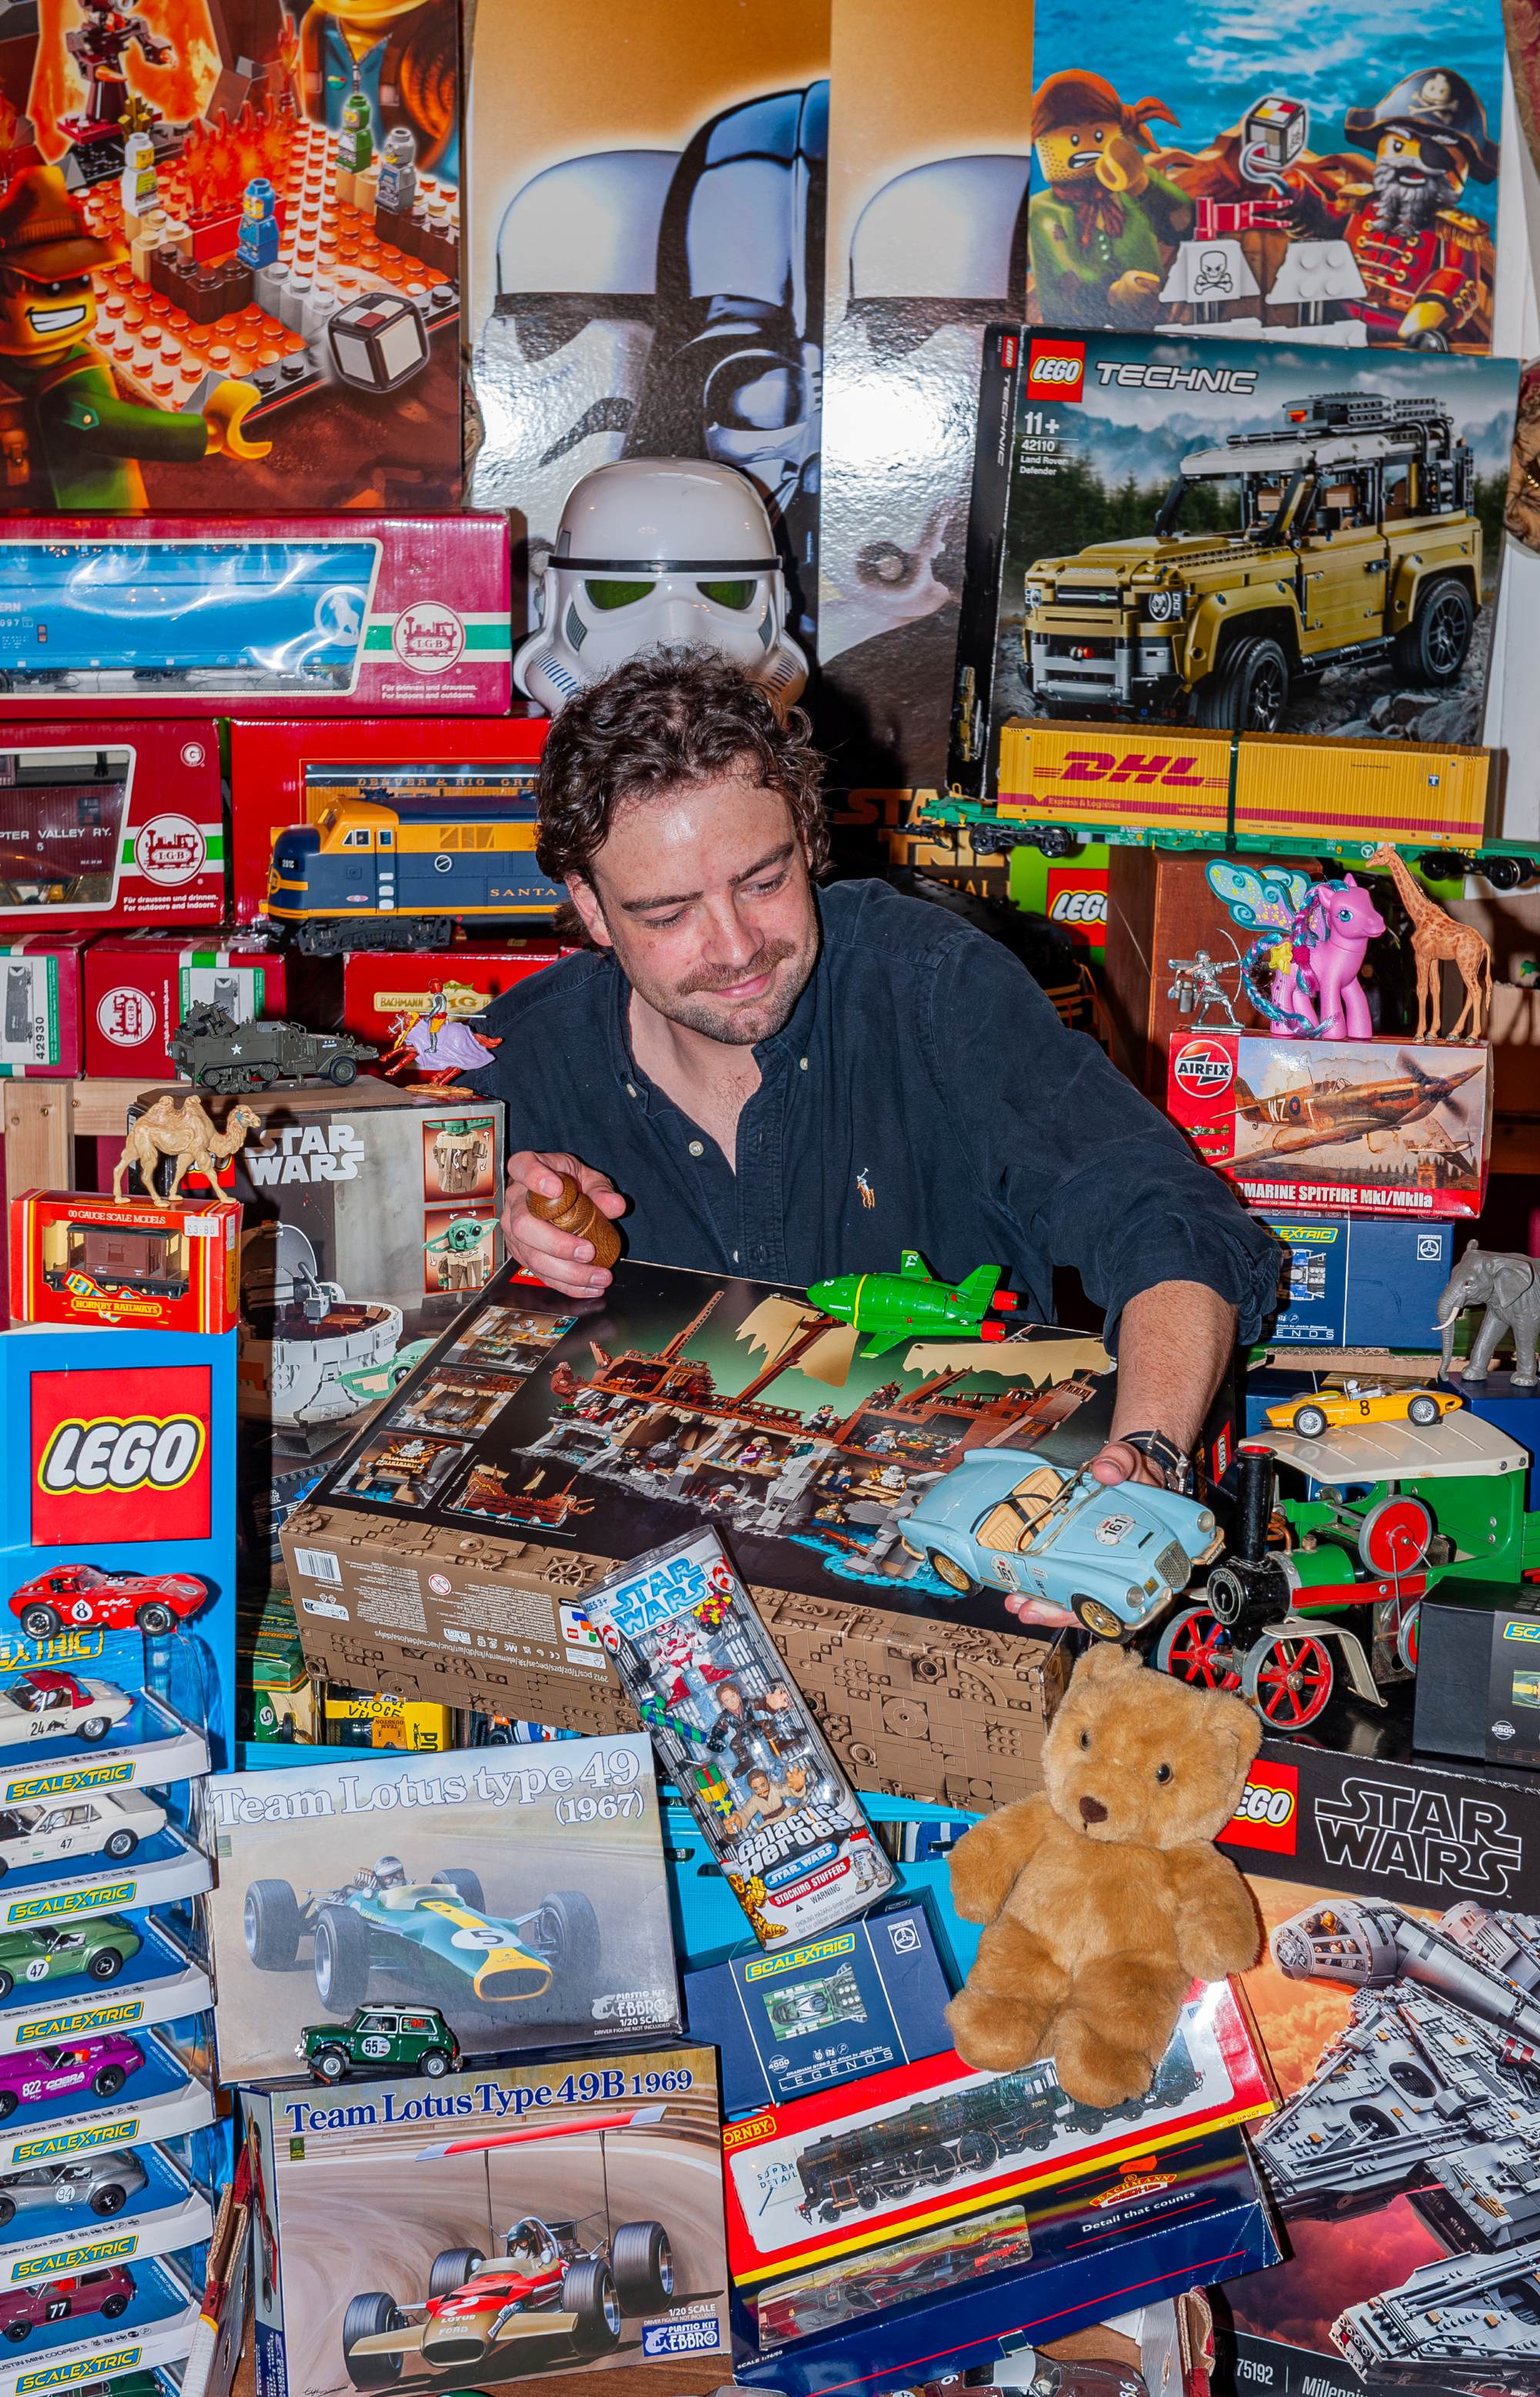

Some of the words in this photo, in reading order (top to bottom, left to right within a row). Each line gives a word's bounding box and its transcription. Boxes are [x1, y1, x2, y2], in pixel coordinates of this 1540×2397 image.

[1006, 339, 1014, 364] LEGO
[1031, 357, 1081, 384] LEGO
[1095, 361, 1258, 395] TECHNIC
[997, 374, 1011, 467] TECHNIC
[1024, 411, 1060, 435] 11+
[1021, 439, 1056, 452] 42110
[1020, 455, 1041, 464] Land
[1043, 457, 1068, 465] Rover
[1019, 465, 1057, 475] Defender
[1060, 751, 1205, 787] DHL
[357, 777, 427, 787] DENVER
[455, 777, 485, 786] RIO
[1048, 797, 1078, 807] Express
[1086, 800, 1121, 810] Logistics
[38, 828, 85, 839] VALLEY
[92, 827, 112, 837] RY.
[123, 896, 136, 904] Für
[489, 888, 557, 897] SANTA
[123, 904, 136, 913] For
[136, 903, 170, 912] outdoors
[1052, 891, 1107, 924] LEG
[380, 997, 424, 1007] BACHMANN
[35, 1016, 45, 1060] 42930
[1177, 1061, 1230, 1078] AIRFIX
[1267, 1098, 1290, 1124] WZ
[245, 1124, 364, 1155] STAR
[246, 1152, 365, 1186] WARS
[1298, 1185, 1358, 1204] SPITFIRE
[78, 1210, 105, 1221] GAUGE
[106, 1212, 132, 1222] SCALE
[133, 1214, 166, 1225] MODELS
[75, 1299, 112, 1311] HORNBY
[113, 1301, 159, 1314] RAILWAYS
[1358, 1400, 1371, 1416] 8
[41, 1416, 203, 1493] LEGO
[1104, 1517, 1128, 1537] 161
[996, 1566, 1016, 1584] 161
[611, 1556, 703, 1617] STAR
[76, 1602, 88, 1618] 8
[615, 1572, 709, 1638] WARS
[592, 1673, 608, 1684] 2912
[30, 1721, 45, 1737] 24
[12, 1764, 128, 1799] SCALEXTRIC
[209, 1782, 336, 1826] Team
[339, 1772, 468, 1815] Lotus
[471, 1760, 573, 1808] type
[574, 1748, 641, 1790] 49
[554, 1789, 644, 1827] (1967)
[1314, 1776, 1522, 1854] STAR
[59, 1837, 72, 1849] 47
[765, 1863, 802, 1886] STAR
[801, 1843, 835, 1868] WARS
[1314, 1816, 1522, 1897] WARS
[774, 1880, 812, 1906] STOCKING
[811, 1862, 847, 1887] STUFFERS
[809, 1882, 843, 1905] WARNING:
[15, 1886, 129, 1919] SCALEXTRIC
[470, 1929, 504, 1945] 5
[750, 1938, 851, 1978] SCALEXTRIC
[29, 1963, 45, 1978] 47
[617, 1990, 650, 2000] PLASTIC
[651, 1989, 666, 1997] KIT
[617, 1998, 668, 2018] EBBRO
[22, 2004, 136, 2040] SCALEXTRIC
[594, 2027, 613, 2036] DRIVER
[644, 2022, 671, 2030] INCLUDED
[619, 2018, 638, 2027] 1/20
[639, 2014, 669, 2025] SCALE
[365, 2040, 378, 2053] 55
[778, 2048, 894, 2090] LEGENDS
[22, 2080, 42, 2097] 822
[45, 2071, 85, 2090] COBRA
[285, 2101, 377, 2134] Team
[381, 2092, 473, 2124] Lotus
[474, 2081, 553, 2117] Type
[557, 2069, 626, 2104] 49B
[630, 2067, 693, 2097] 1969
[1031, 2098, 1047, 2109] 70010
[18, 2122, 132, 2161] SCALEXTRIC
[723, 2119, 768, 2145] ORNBY
[757, 2163, 795, 2181] SUPER
[58, 2187, 74, 2201] 94
[1096, 2174, 1171, 2204] BACHMANN
[1082, 2214, 1120, 2233] Detail
[1123, 2207, 1150, 2220] that
[1153, 2191, 1196, 2210] counts
[25, 2241, 48, 2250] Cobra
[18, 2239, 130, 2277] SCALEXTRIC
[50, 2301, 67, 2318] 77
[440, 2314, 476, 2324] LOTUS
[661, 2316, 678, 2325] FIGURE
[691, 2312, 716, 2320] INCLUDED
[668, 2308, 686, 2317] 1/20
[688, 2303, 716, 2315] SCALE
[438, 2325, 469, 2336] FORD
[668, 2322, 700, 2333] PLASTIC
[701, 2321, 717, 2329] KIT
[669, 2329, 718, 2351] EBBRO
[25, 2355, 45, 2365] MINI
[45, 2347, 79, 2361] COOPER
[737, 2358, 760, 2370] SCALE
[22, 2351, 135, 2391] SCALEXTRIC
[1236, 2358, 1274, 2385] 75192
